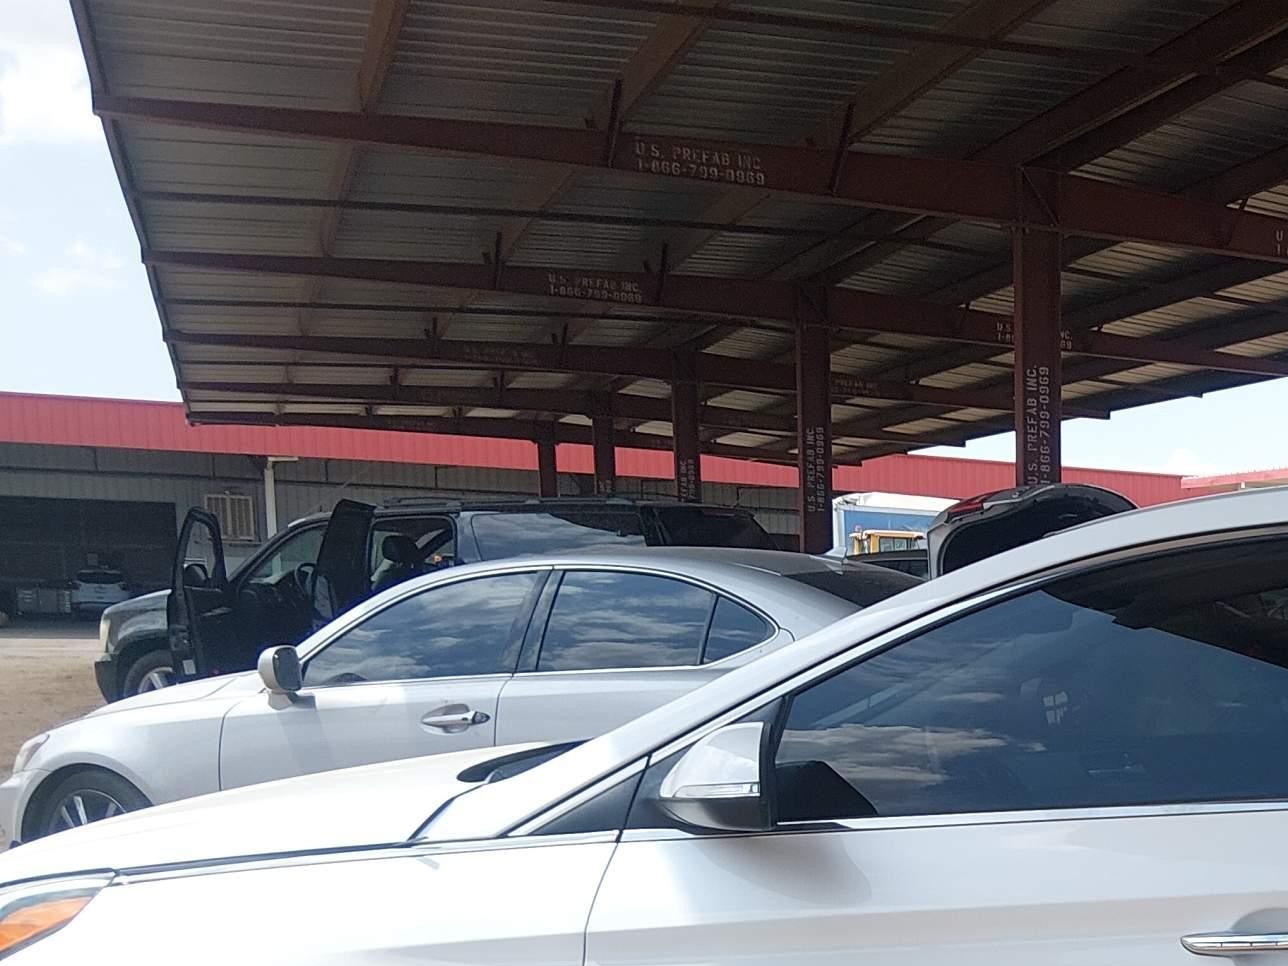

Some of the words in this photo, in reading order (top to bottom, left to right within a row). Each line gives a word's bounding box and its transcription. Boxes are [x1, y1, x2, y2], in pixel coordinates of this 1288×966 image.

[672, 144, 730, 167] PREFAB
[637, 157, 766, 186] 1-866-799-0969
[1026, 364, 1038, 391] INC.
[1026, 397, 1038, 452] PREFAB
[1039, 366, 1051, 485] 1-866-799-0969
